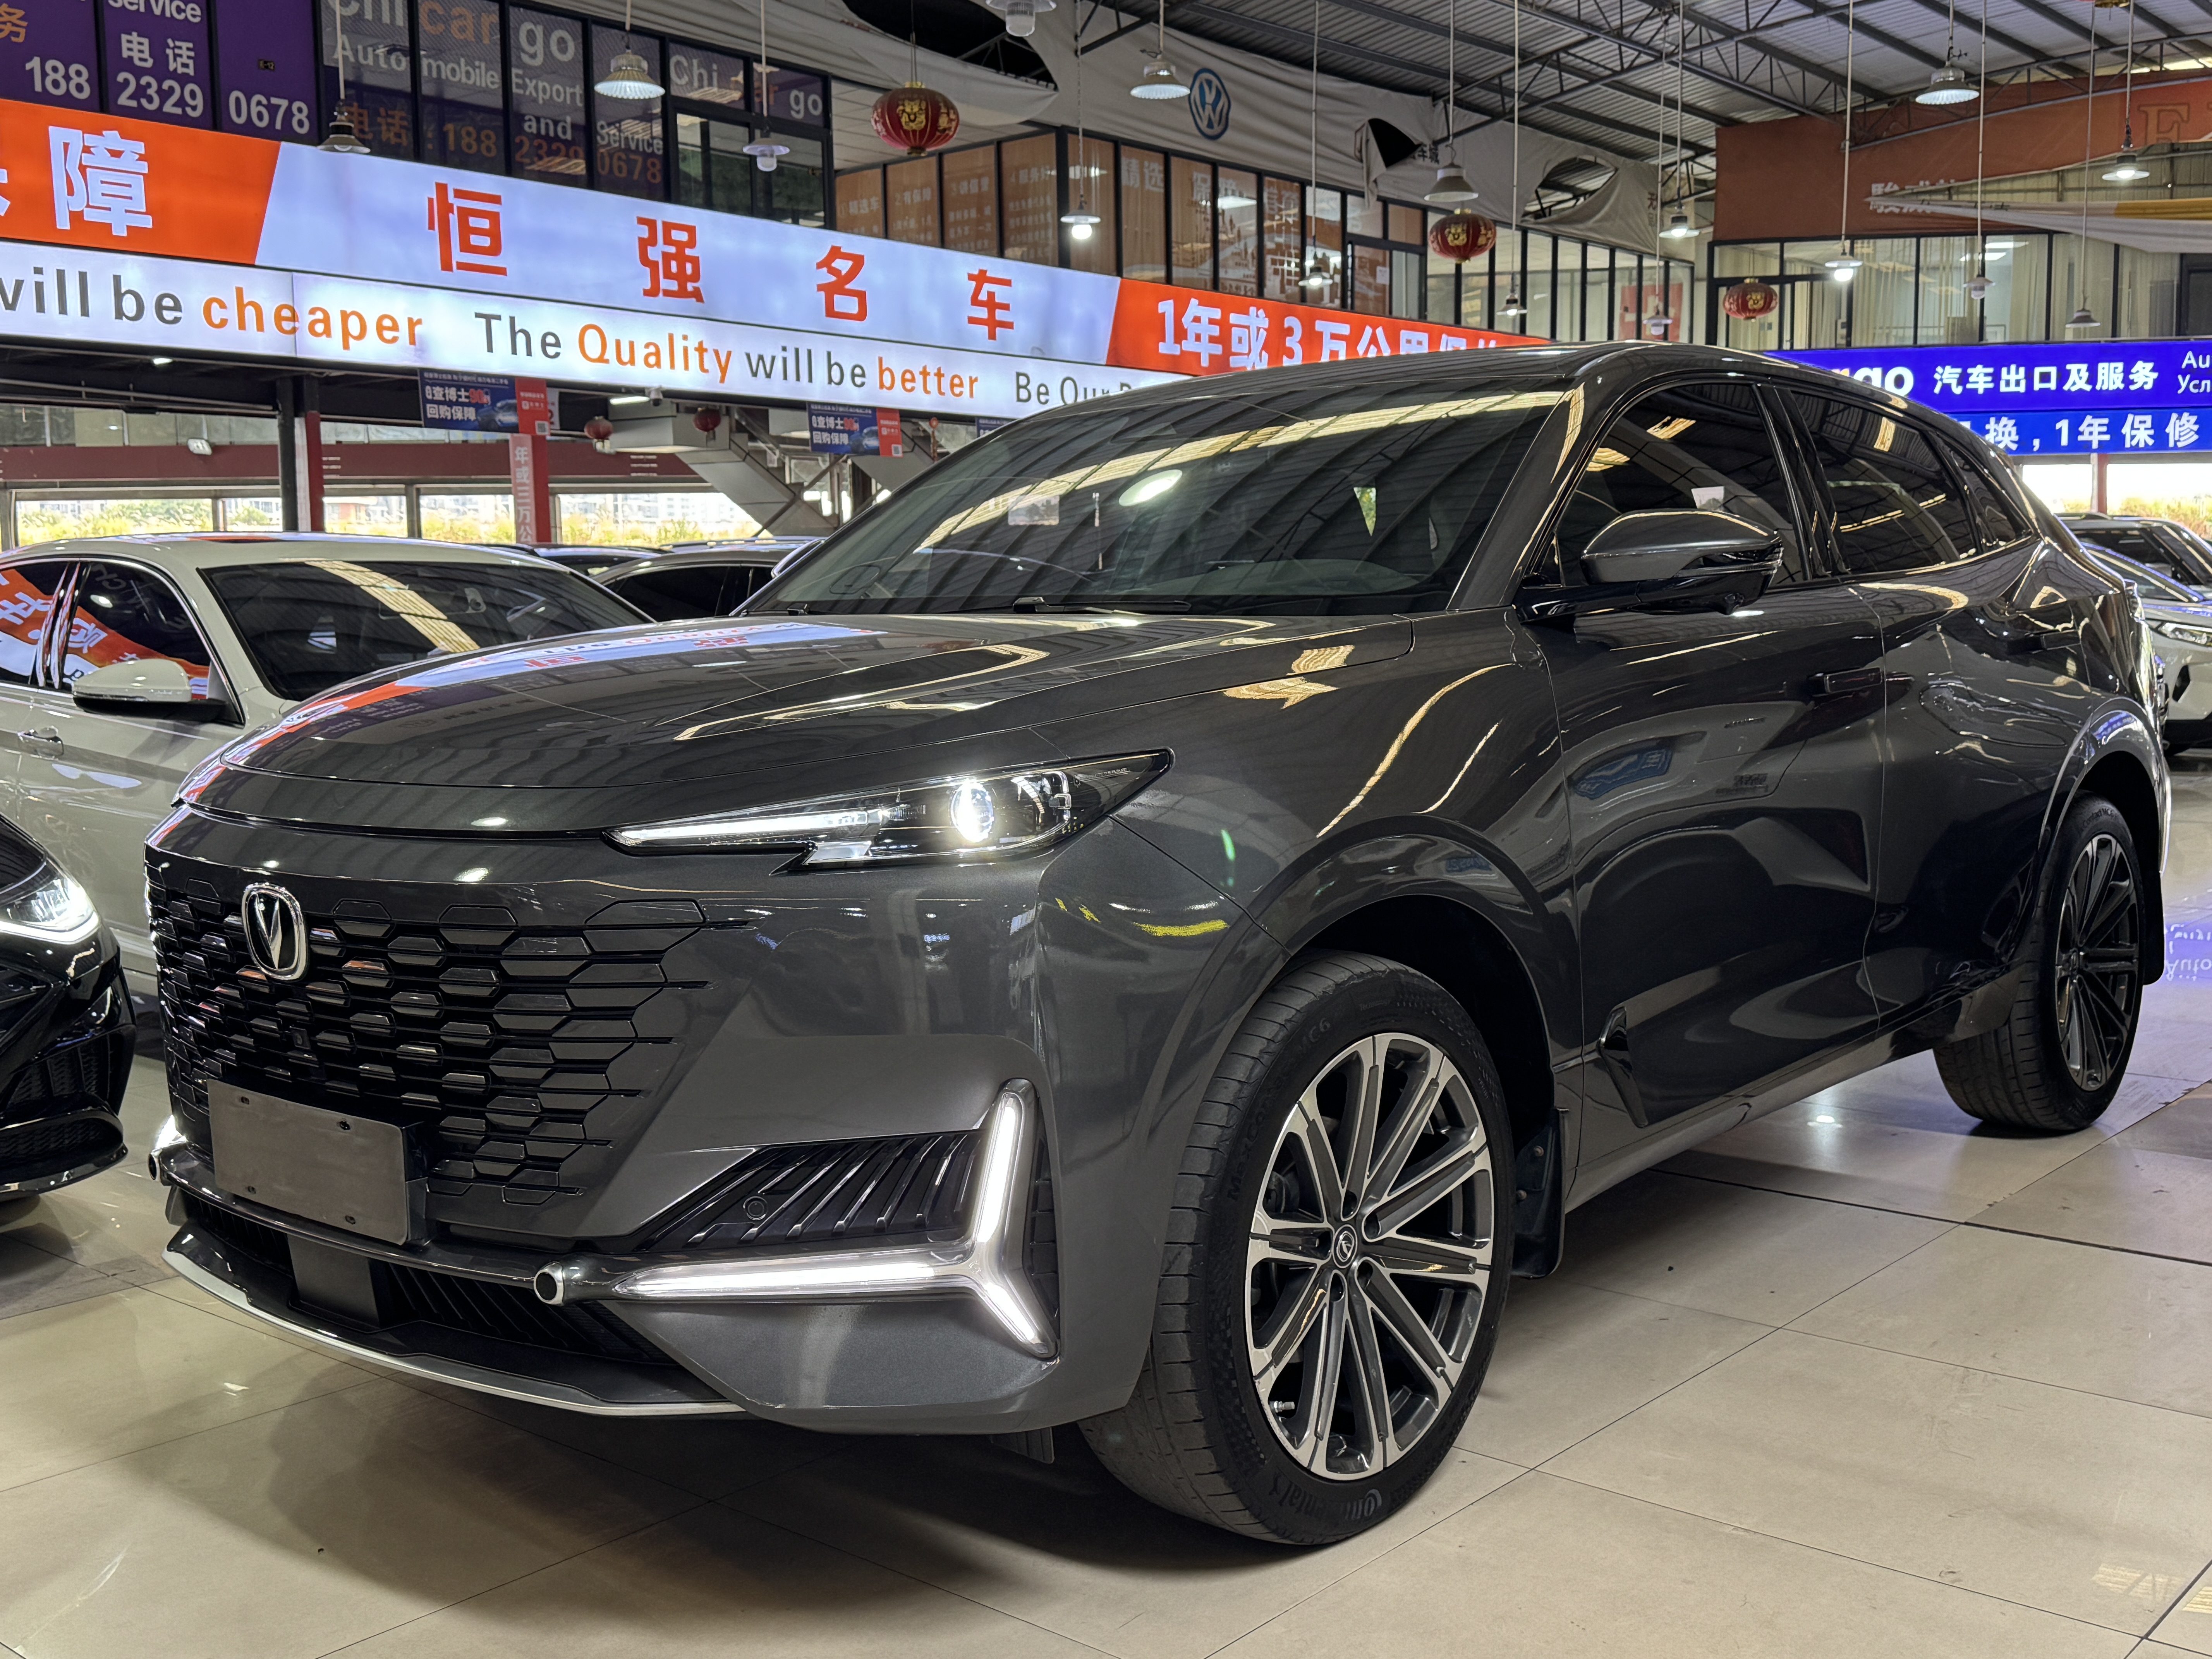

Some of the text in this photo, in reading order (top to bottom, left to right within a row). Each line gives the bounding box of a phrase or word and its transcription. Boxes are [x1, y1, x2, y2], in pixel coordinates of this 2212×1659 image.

[108, 0, 201, 22] ervice
[120, 32, 195, 76] 电话
[25, 56, 310, 134] 188 2329 0678
[511, 67, 583, 107] Export
[790, 89, 823, 118] go
[524, 115, 572, 141] and
[113, 275, 183, 325] be
[203, 286, 423, 351] cheaper
[475, 312, 561, 359] The
[578, 324, 732, 383] Quality
[745, 345, 814, 383] will
[827, 351, 866, 388] be
[878, 356, 979, 399] better
[1016, 371, 1050, 405] Be
[2181, 350, 2212, 369] Au
[1933, 361, 2159, 395] 汽车出口及服务
